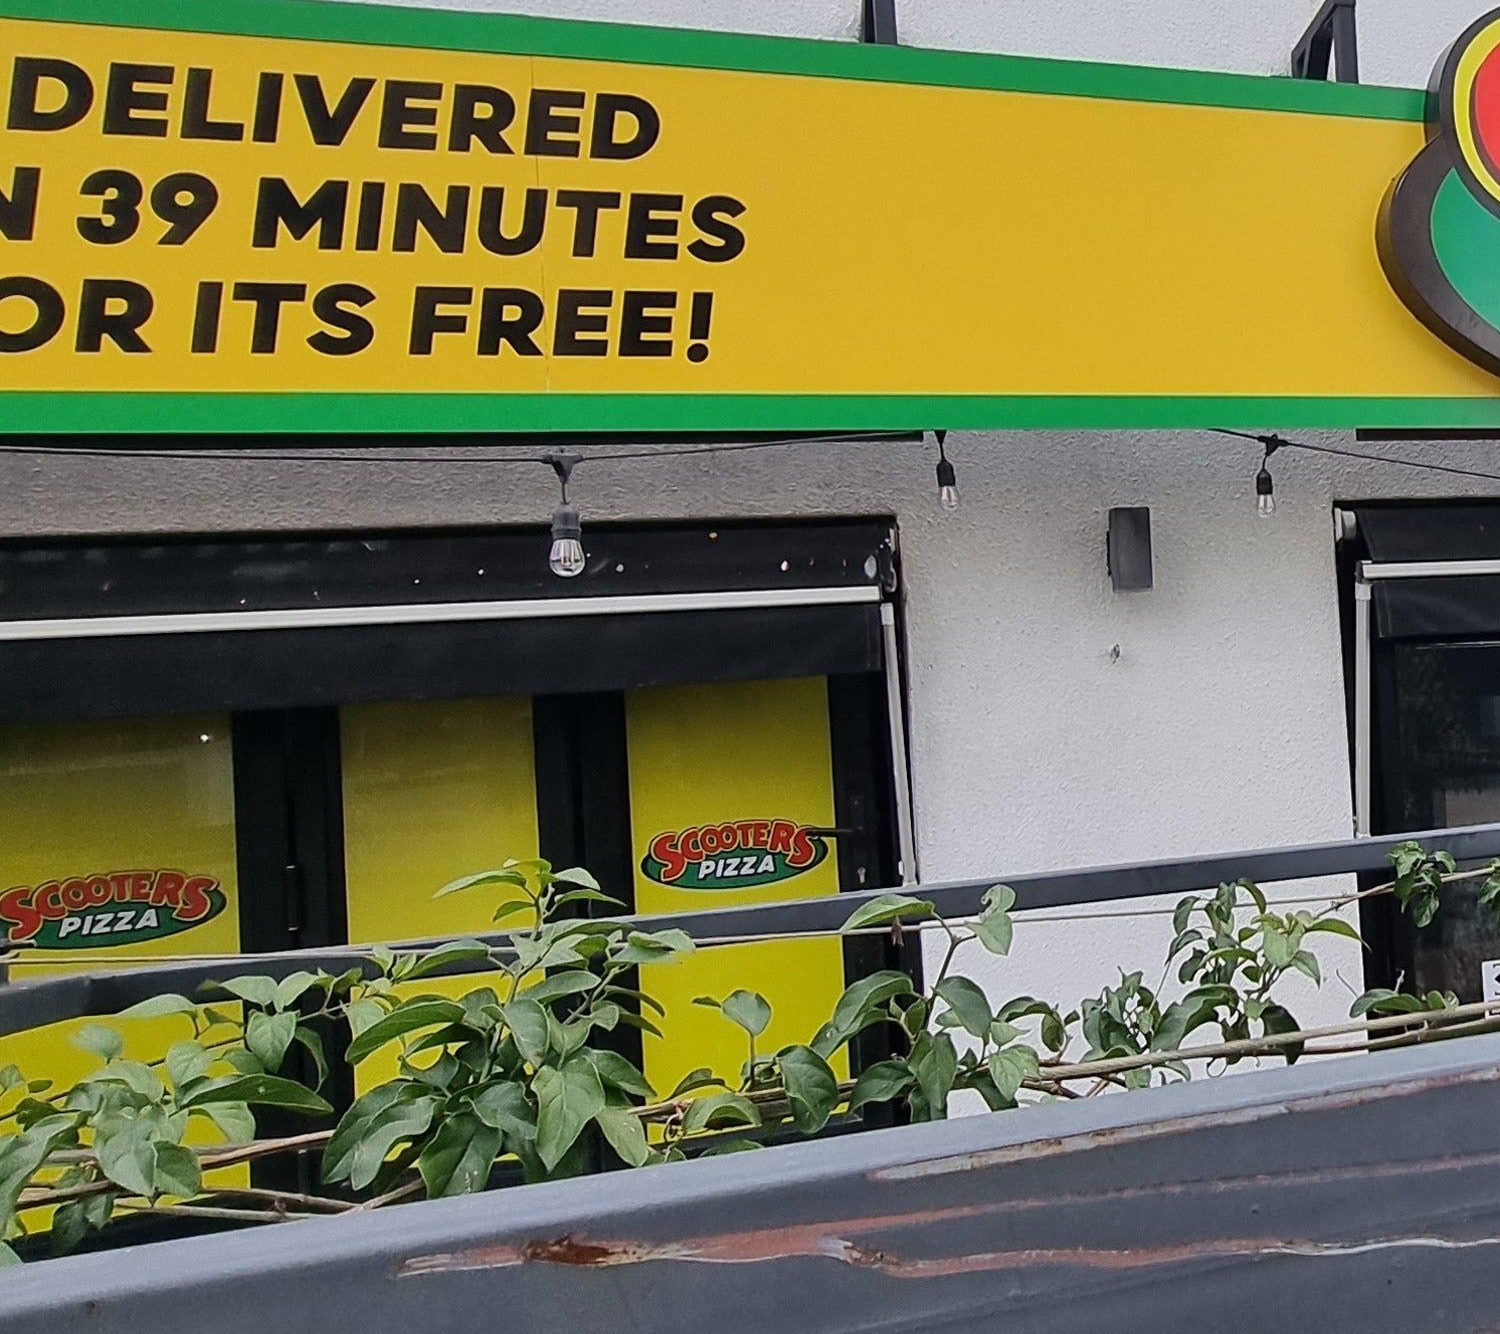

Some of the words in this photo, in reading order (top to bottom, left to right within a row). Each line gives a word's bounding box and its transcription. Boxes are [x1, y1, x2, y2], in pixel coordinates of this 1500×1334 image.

[7, 56, 661, 161] DELIVERED
[76, 168, 219, 246] 39
[251, 177, 748, 262] MINUTES
[0, 276, 154, 355] OR
[190, 281, 377, 356] ITS
[408, 286, 714, 364] FREE!
[650, 819, 820, 882] SCOOTERS
[698, 854, 775, 880] PIZZA
[0, 868, 218, 942] SCOOTERS
[58, 908, 158, 938] PIZZA
